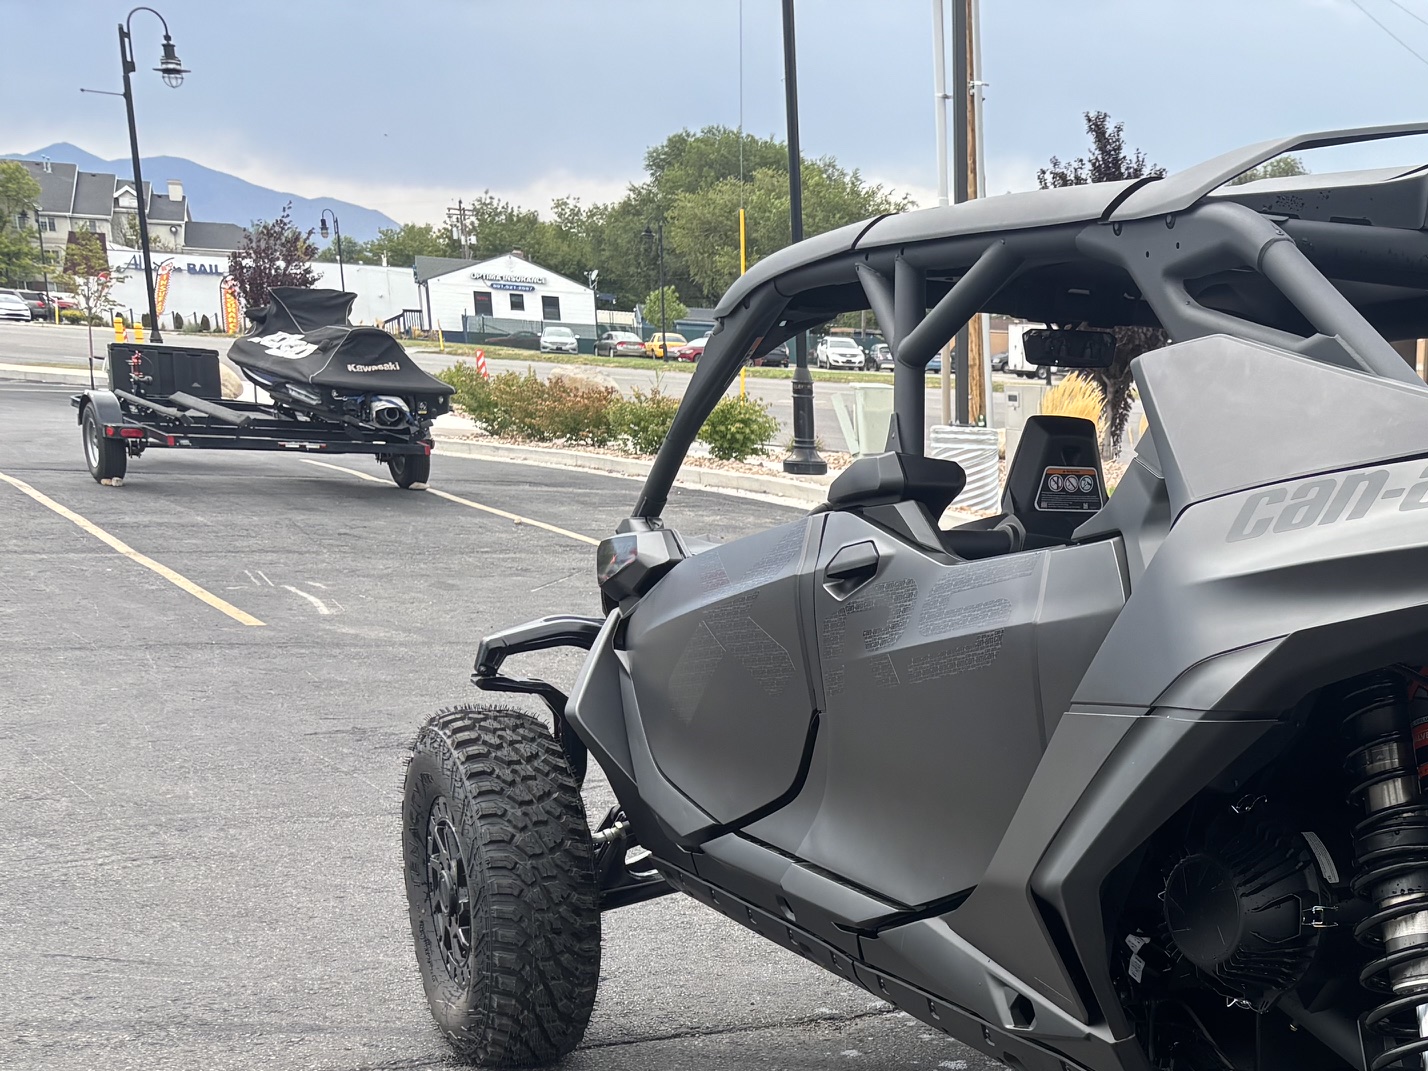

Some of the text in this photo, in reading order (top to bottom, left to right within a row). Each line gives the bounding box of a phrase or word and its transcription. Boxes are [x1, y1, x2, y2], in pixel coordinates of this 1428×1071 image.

[187, 262, 224, 276] BAIL
[470, 272, 547, 284] OPTIMA INSURANCE
[346, 361, 401, 373] Kawasaki
